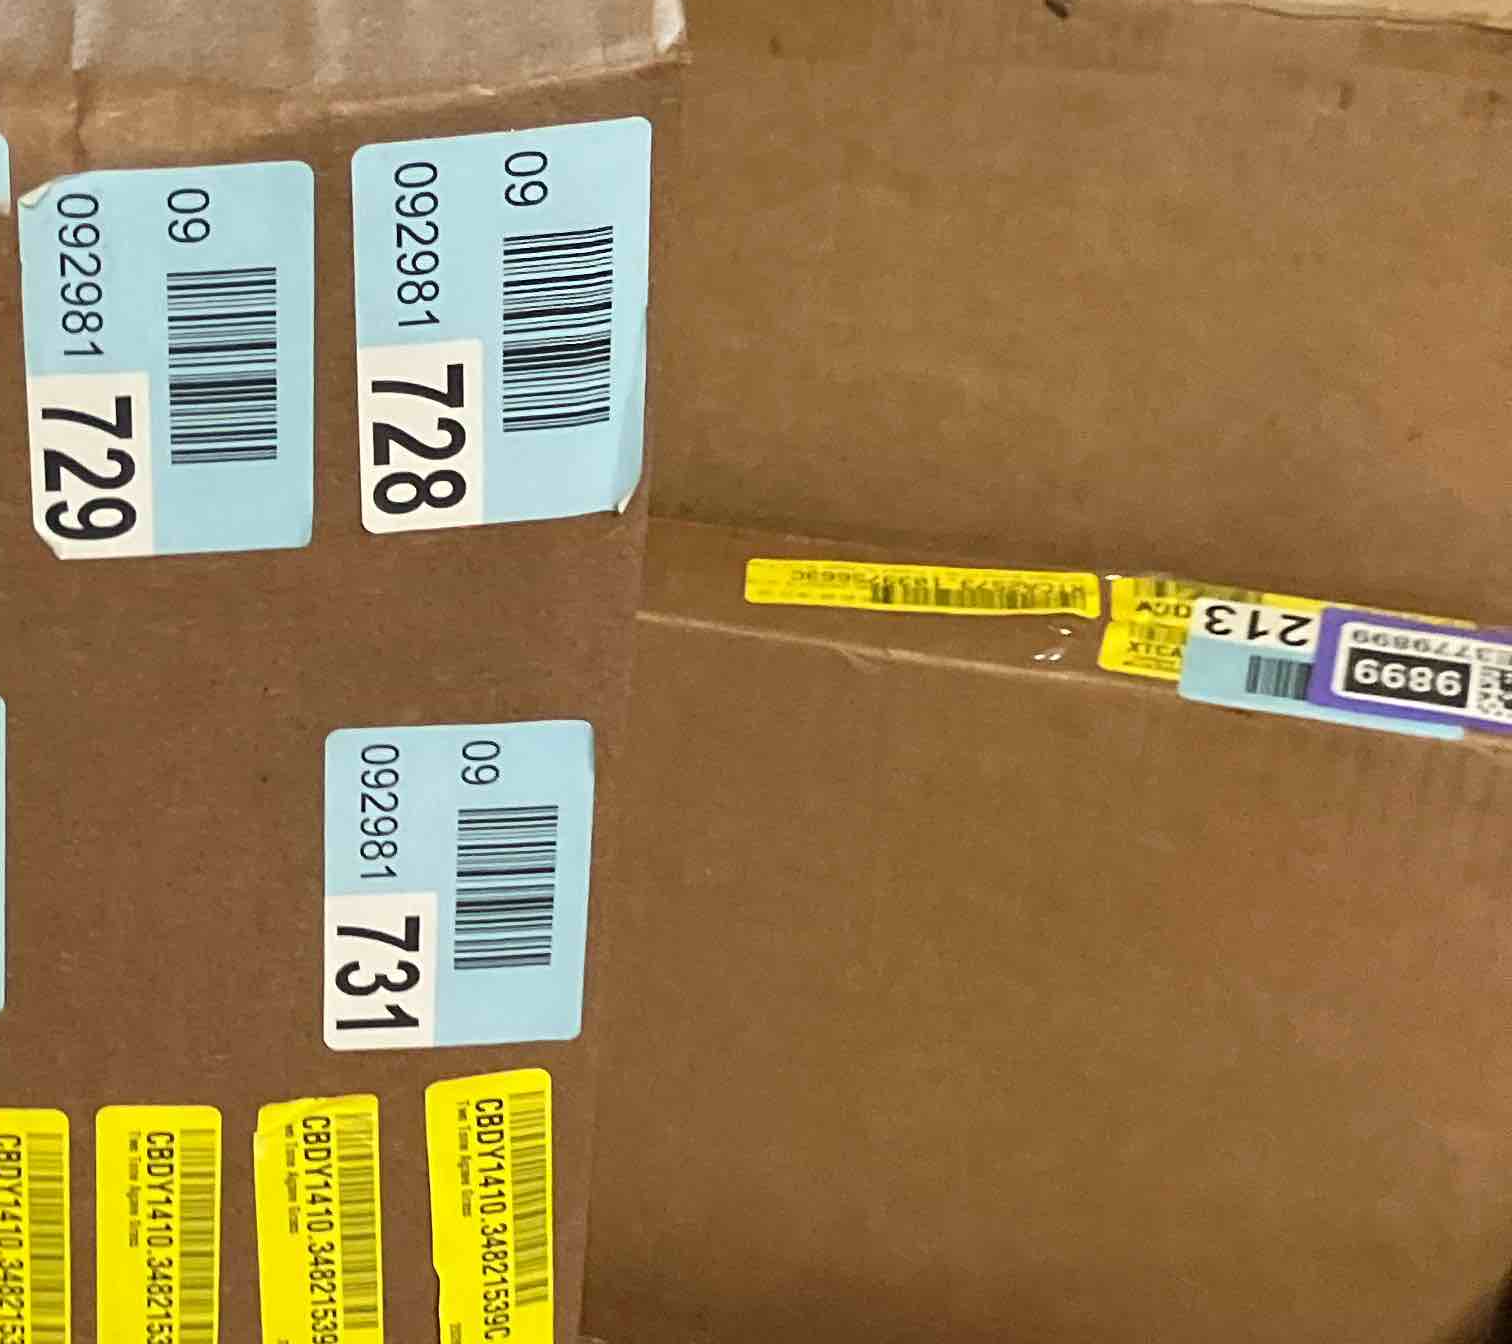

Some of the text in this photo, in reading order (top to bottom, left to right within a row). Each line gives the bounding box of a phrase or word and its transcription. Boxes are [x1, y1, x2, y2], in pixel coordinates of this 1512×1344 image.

[166, 188, 211, 244] 09
[504, 149, 550, 208] 09
[55, 193, 104, 362] 092981
[393, 160, 440, 329] 092981
[40, 395, 138, 542] 729
[368, 362, 467, 517] 728
[1203, 604, 1314, 647] 213
[1354, 659, 1462, 698] 9899
[358, 742, 399, 882] 092981
[460, 738, 502, 787] 09
[334, 914, 420, 1033] 731
[474, 1098, 512, 1341] CBDY1410.34821539C
